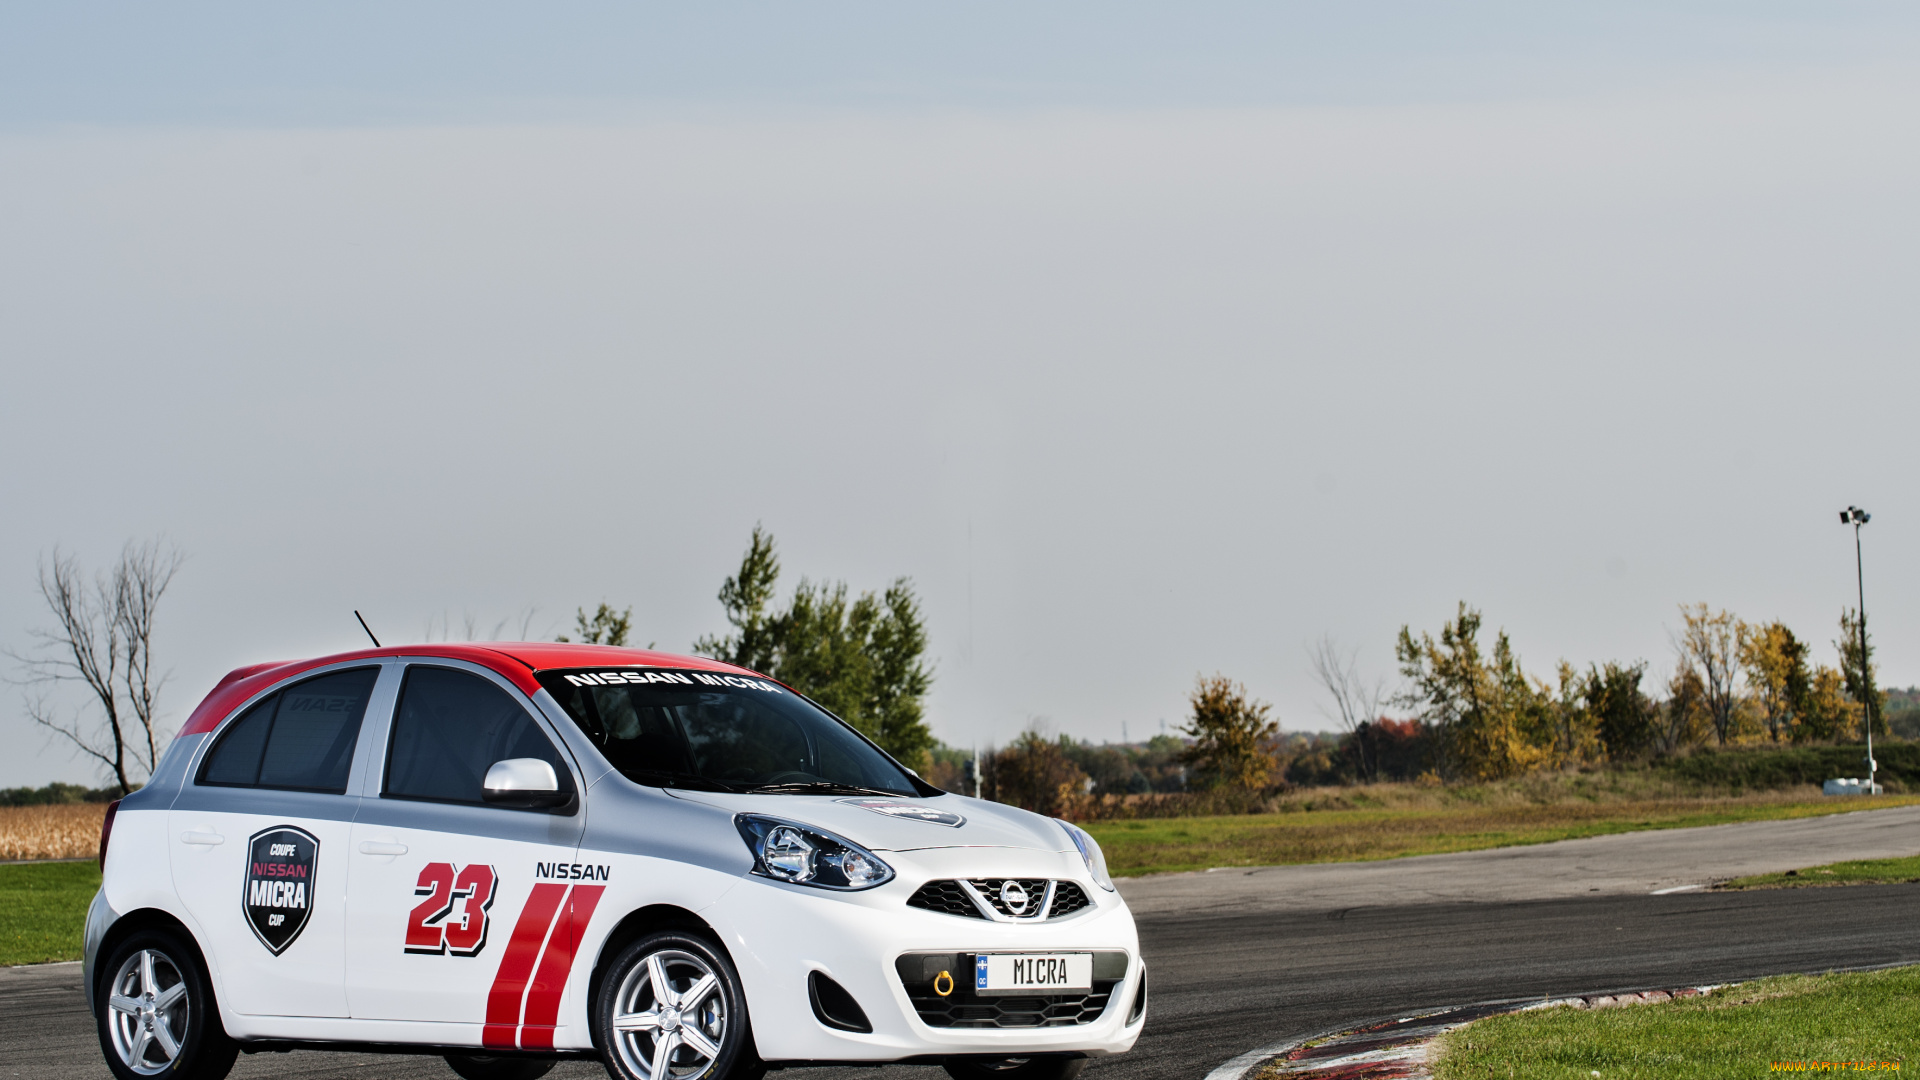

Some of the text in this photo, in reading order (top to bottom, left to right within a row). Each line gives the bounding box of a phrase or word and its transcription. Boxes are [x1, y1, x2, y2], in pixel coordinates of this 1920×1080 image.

[564, 672, 783, 694] NISSAN MICRA
[270, 843, 297, 856] COUPE
[252, 862, 307, 878] NISSAN
[536, 862, 610, 881] NISSAN
[250, 880, 306, 909] MICRA
[268, 913, 285, 927] CUP
[404, 862, 499, 958] 23
[1014, 959, 1067, 984] MICRA
